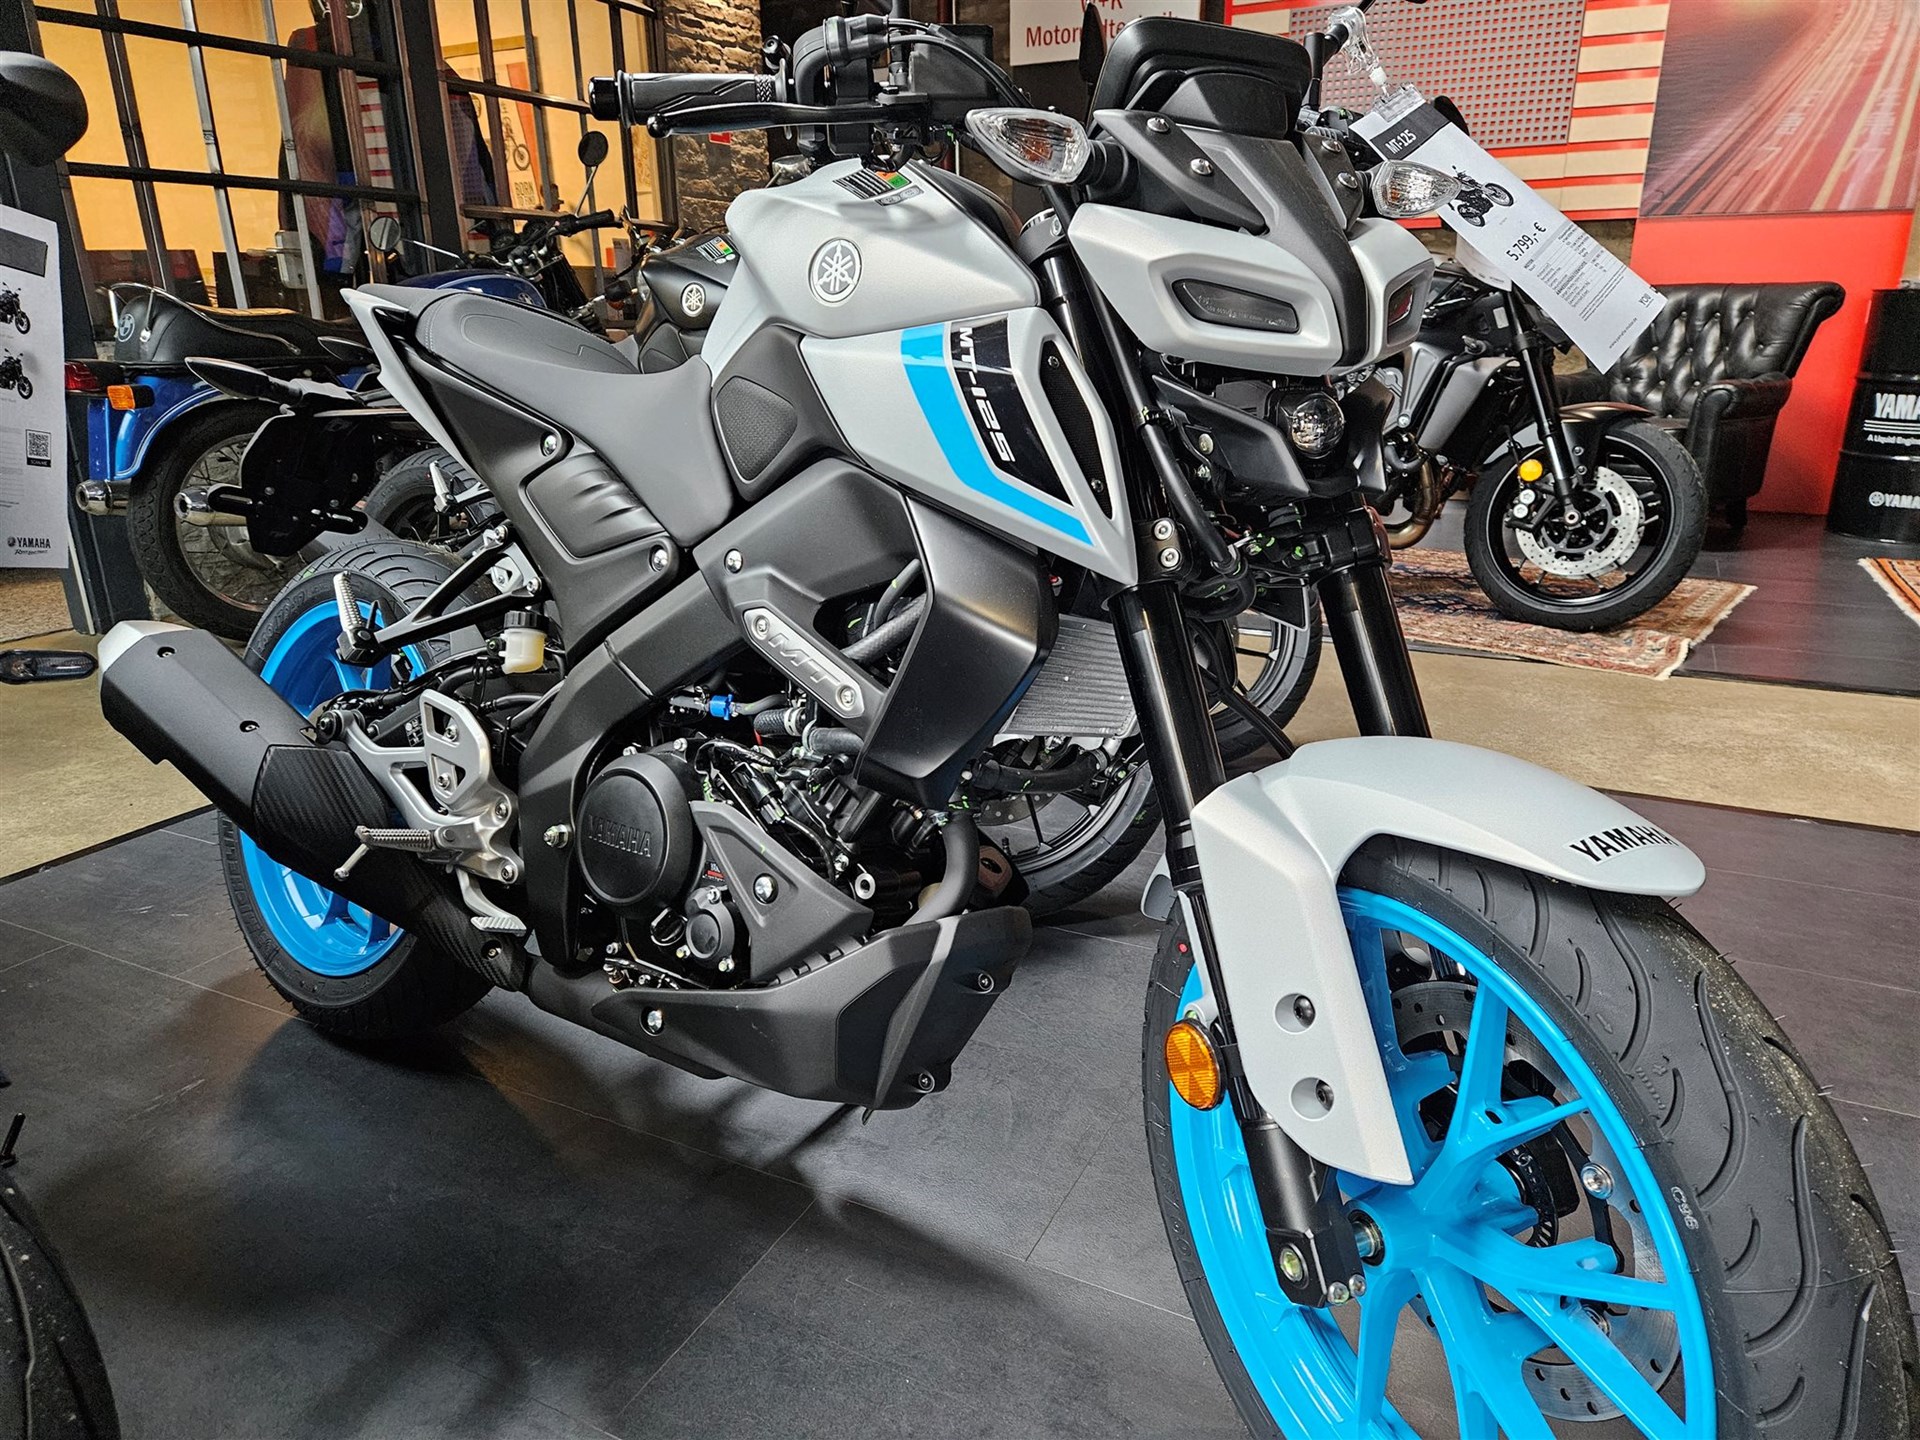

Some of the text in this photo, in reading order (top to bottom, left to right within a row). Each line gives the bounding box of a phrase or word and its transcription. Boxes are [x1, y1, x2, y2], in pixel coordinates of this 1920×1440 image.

[1385, 129, 1417, 154] MT-125
[1533, 221, 1547, 233] €
[959, 327, 1016, 462] MT-125
[17, 536, 51, 549] YAMAHA
[768, 633, 840, 686] MT
[589, 815, 651, 857] YAMAHA
[1569, 825, 1679, 862] YAMAHA
